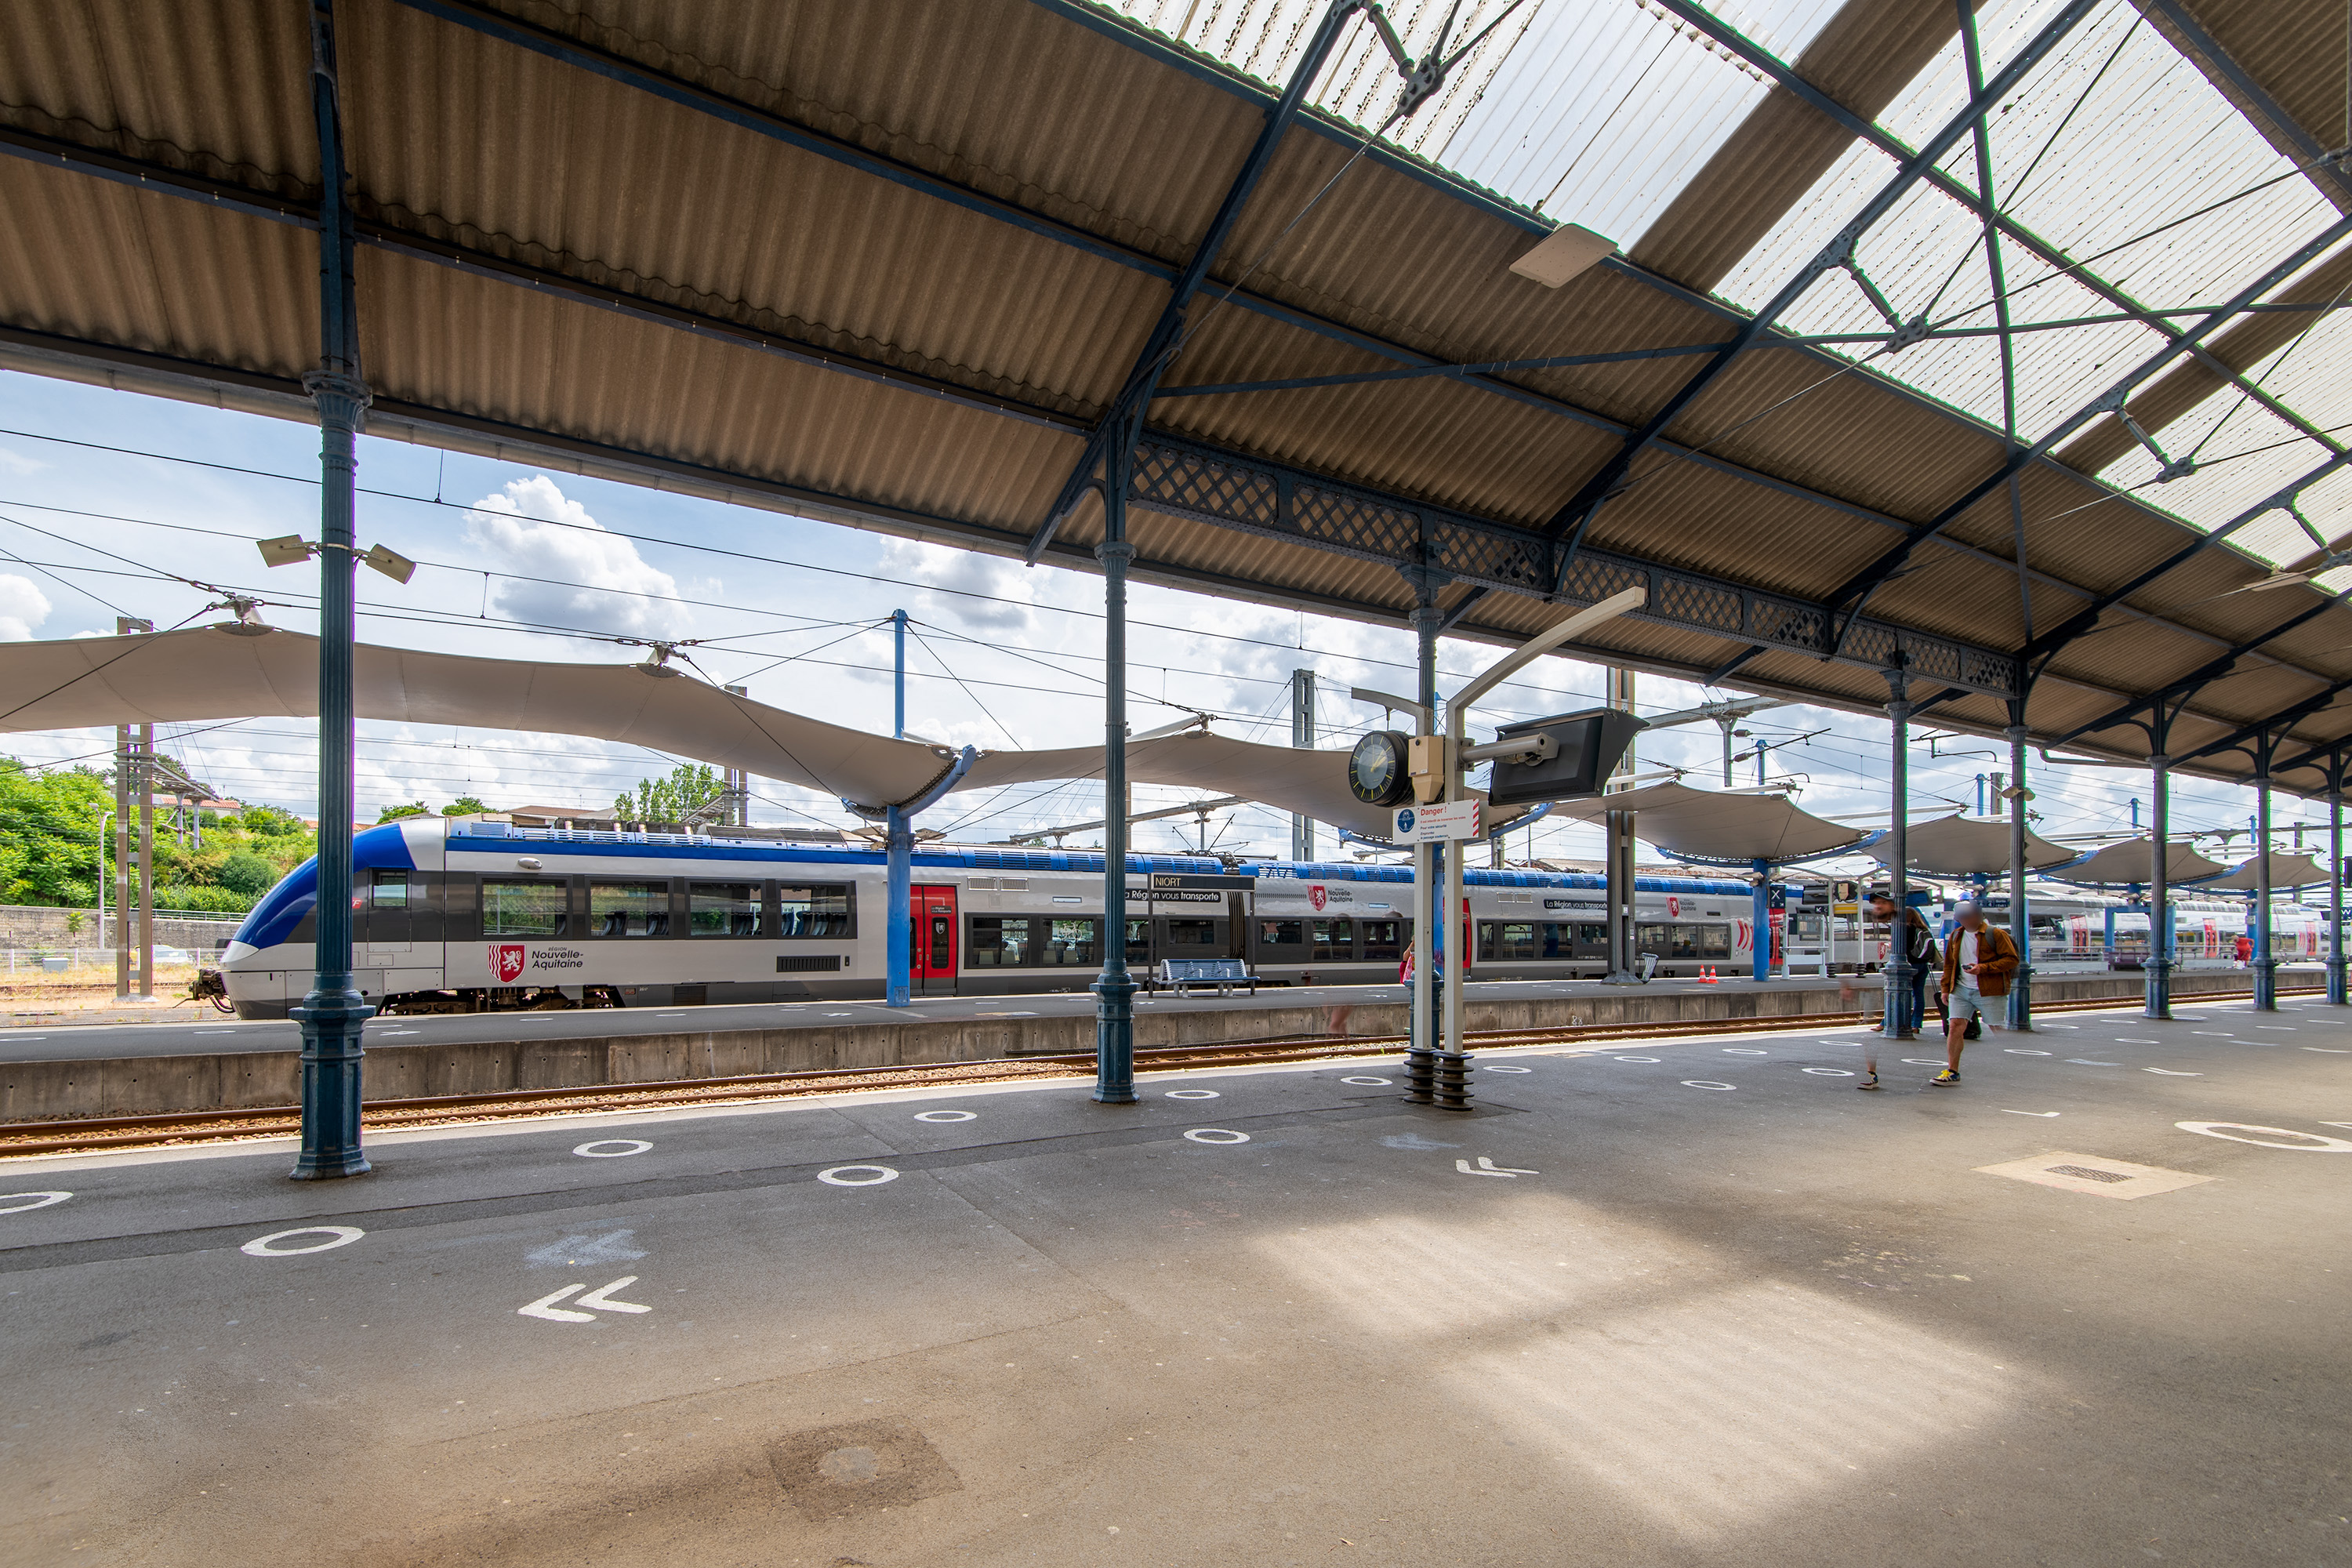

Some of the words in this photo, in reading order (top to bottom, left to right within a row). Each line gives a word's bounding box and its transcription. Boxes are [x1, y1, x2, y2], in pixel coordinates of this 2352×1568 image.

[1156, 877, 1181, 887] NIORT
[1181, 892, 1219, 901] transporte
[532, 950, 584, 959] Nouvelle-
[532, 960, 583, 971] Aquitaine
